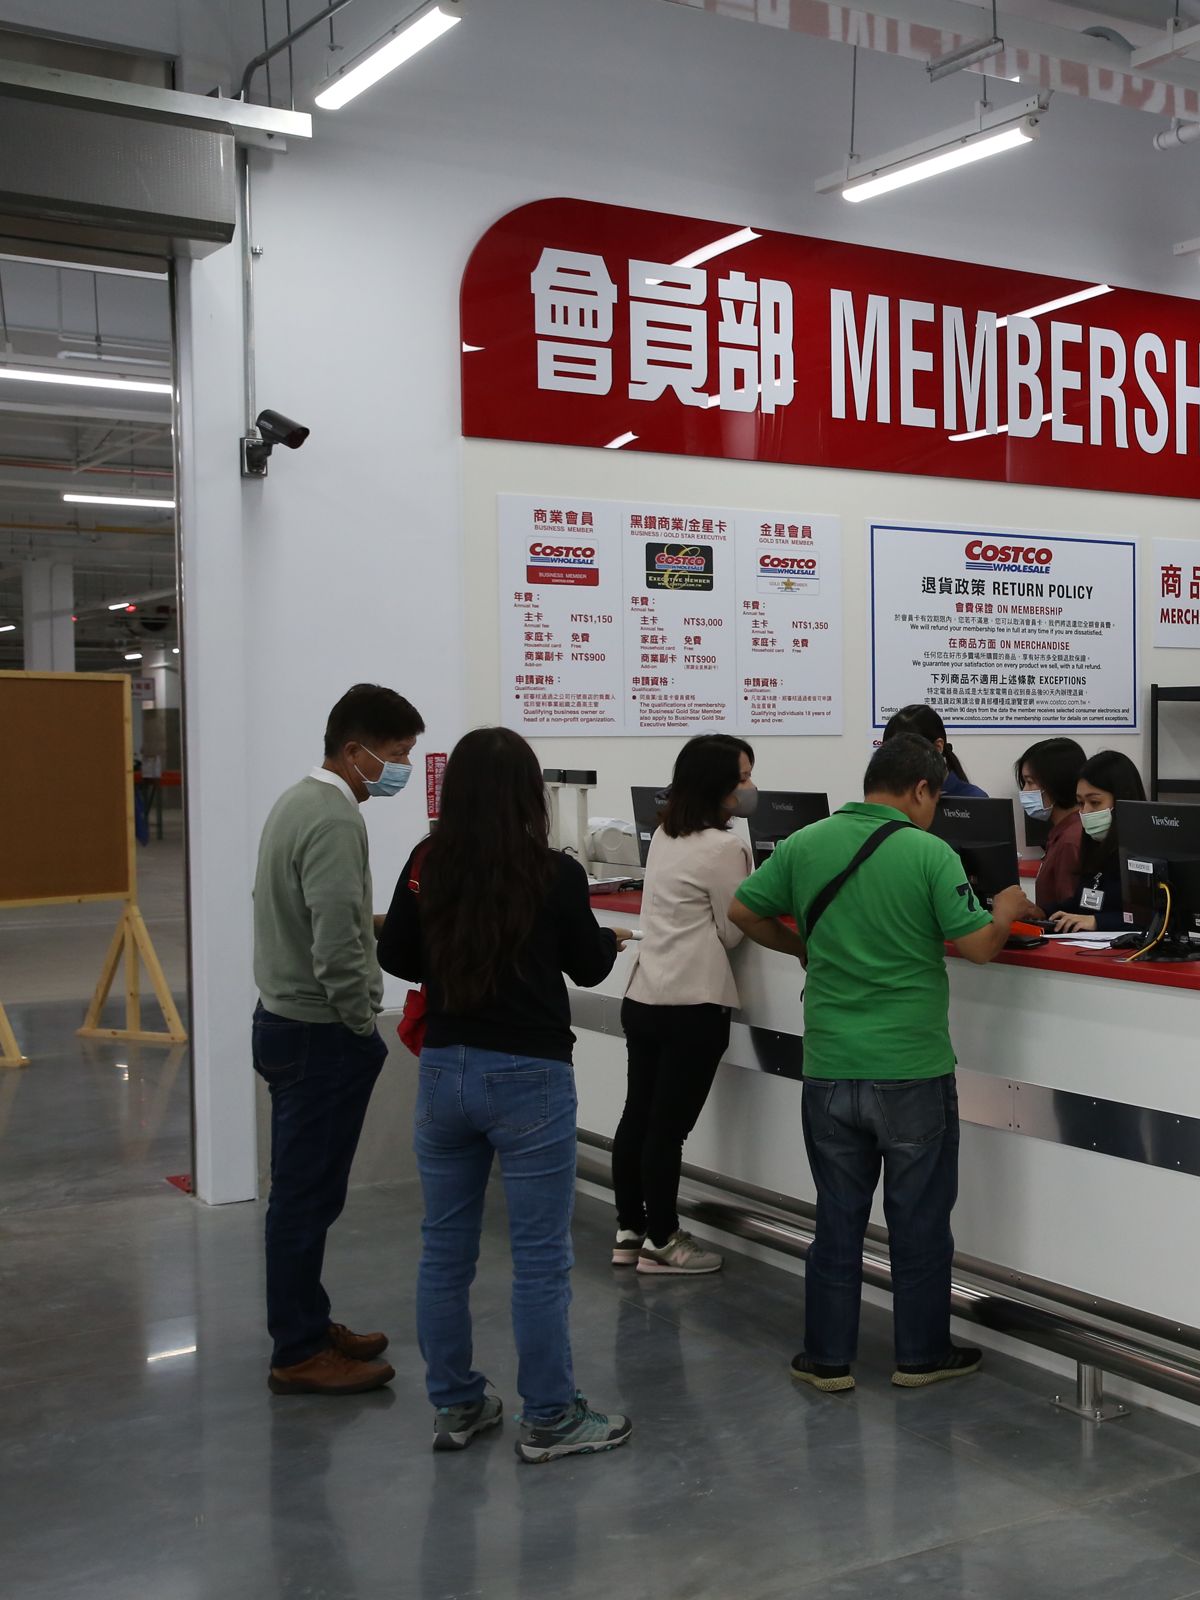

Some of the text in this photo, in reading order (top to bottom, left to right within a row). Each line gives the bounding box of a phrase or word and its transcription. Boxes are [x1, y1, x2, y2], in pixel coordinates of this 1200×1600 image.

[530, 247, 794, 414] 會員部
[533, 508, 594, 526] 商業會員
[534, 524, 565, 532] BUSINESS
[760, 523, 812, 539] 金星會員
[529, 543, 595, 558] COSTCO
[965, 540, 1053, 565] COSTCO
[550, 557, 594, 565] WHOLESALE
[655, 553, 705, 566] COSTCO
[759, 555, 816, 569] COSTCO
[992, 563, 1050, 574] WHOLESALE
[921, 576, 1093, 600] 退貨政策 RETURN POLICY
[955, 602, 1063, 616] 會費保證 ON MEMBERSHIP
[524, 612, 543, 622] 主卡
[570, 614, 613, 624] NT$1,150
[640, 616, 658, 625] 主卡
[684, 618, 723, 627] NT$3,000
[752, 619, 768, 629] 主卡
[792, 621, 829, 630] NT$1,350
[524, 631, 554, 642] 家庭卡
[571, 632, 590, 643] 免費
[640, 634, 668, 644] 家庭卡
[684, 636, 702, 645] 免費
[752, 637, 777, 647] 家庭卡
[792, 639, 808, 647] 免費
[948, 638, 1070, 650] 在商品方面 ON MERCHANDISE
[524, 651, 564, 661] 商業副卡
[571, 653, 606, 661] NT$900
[640, 653, 677, 664] 商業副卡
[684, 655, 716, 664] NT$900
[931, 673, 1087, 685] 下列商品不適用上述條款 EXCEPTIONS
[1151, 815, 1180, 827] ViewSonic
